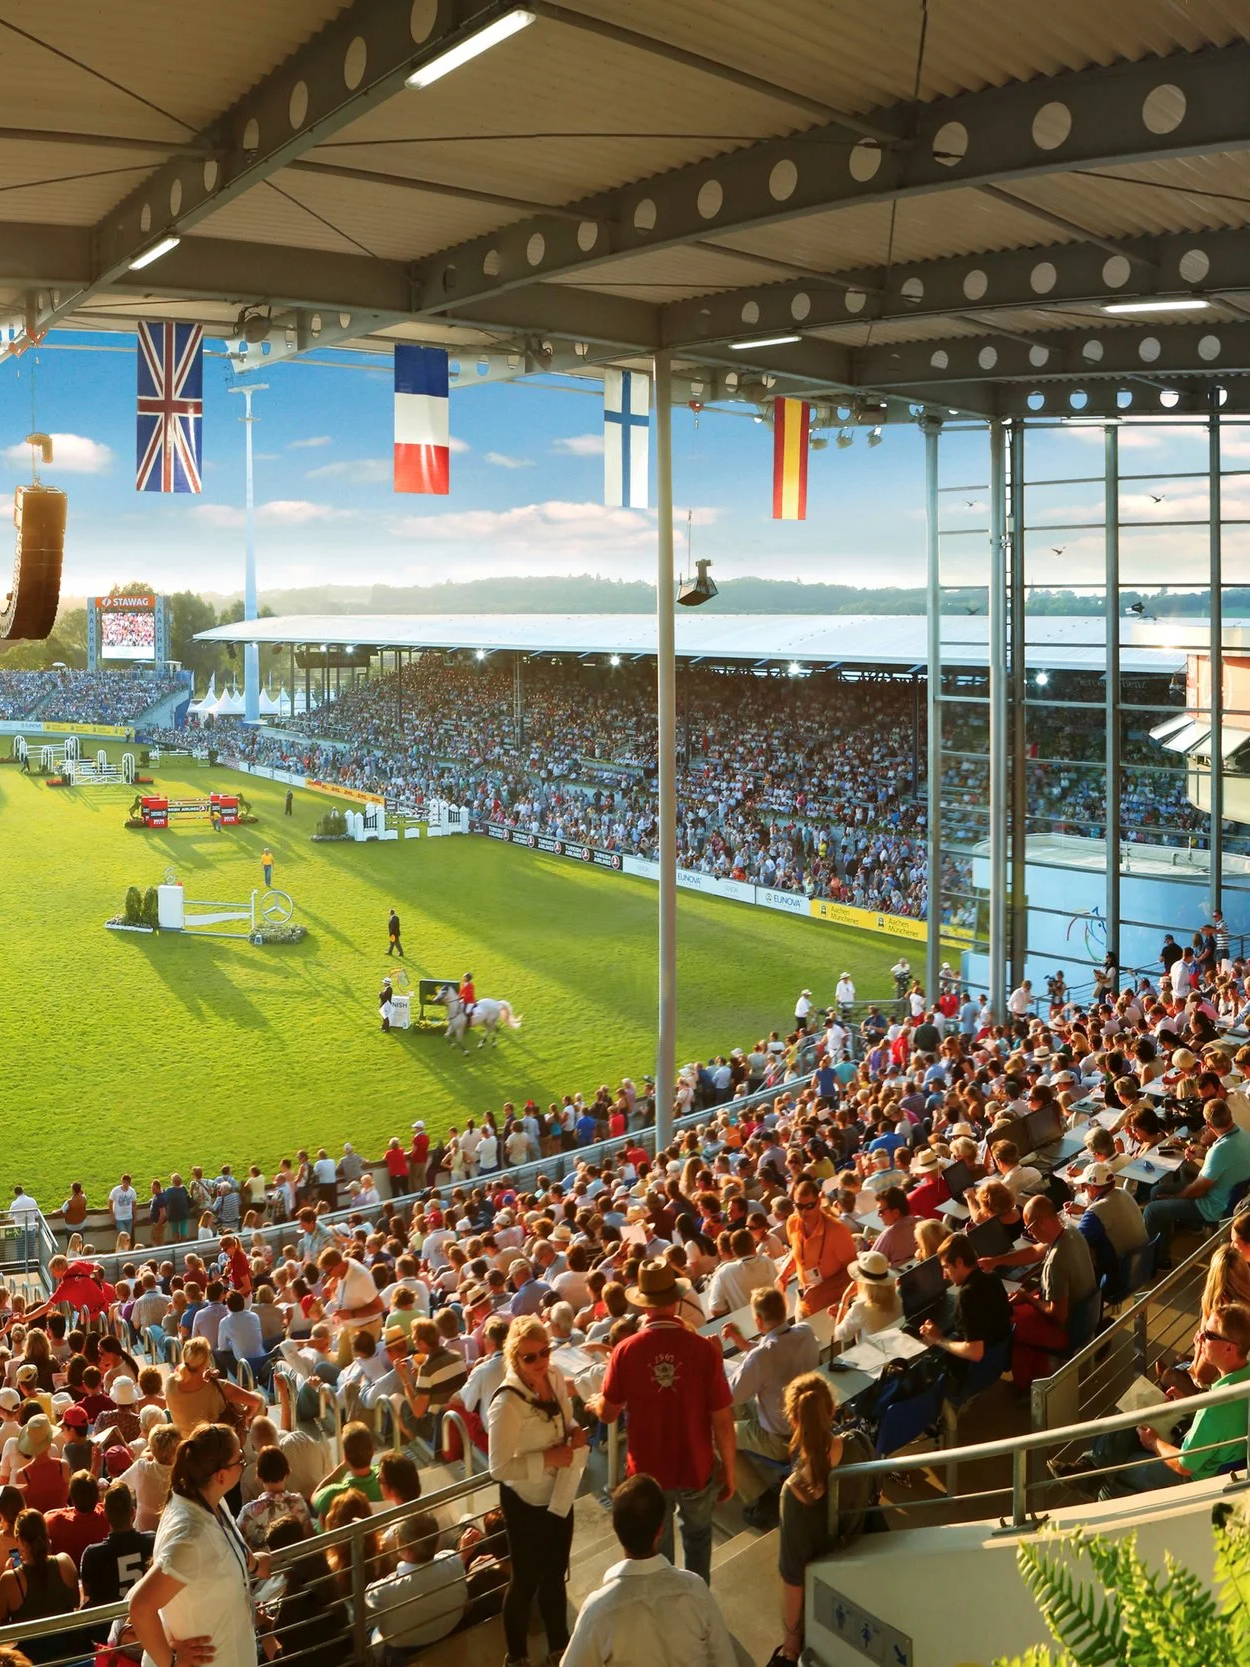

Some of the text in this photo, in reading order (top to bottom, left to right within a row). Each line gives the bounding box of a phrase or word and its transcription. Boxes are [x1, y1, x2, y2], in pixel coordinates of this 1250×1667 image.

[113, 598, 149, 606] STAWAG
[677, 873, 701, 884] EUNOVA
[773, 894, 800, 907] EUNOVA
[830, 905, 850, 916] Aachen
[888, 917, 910, 929] Aachen
[887, 925, 920, 938] Münchener
[117, 1552, 143, 1598] 5
